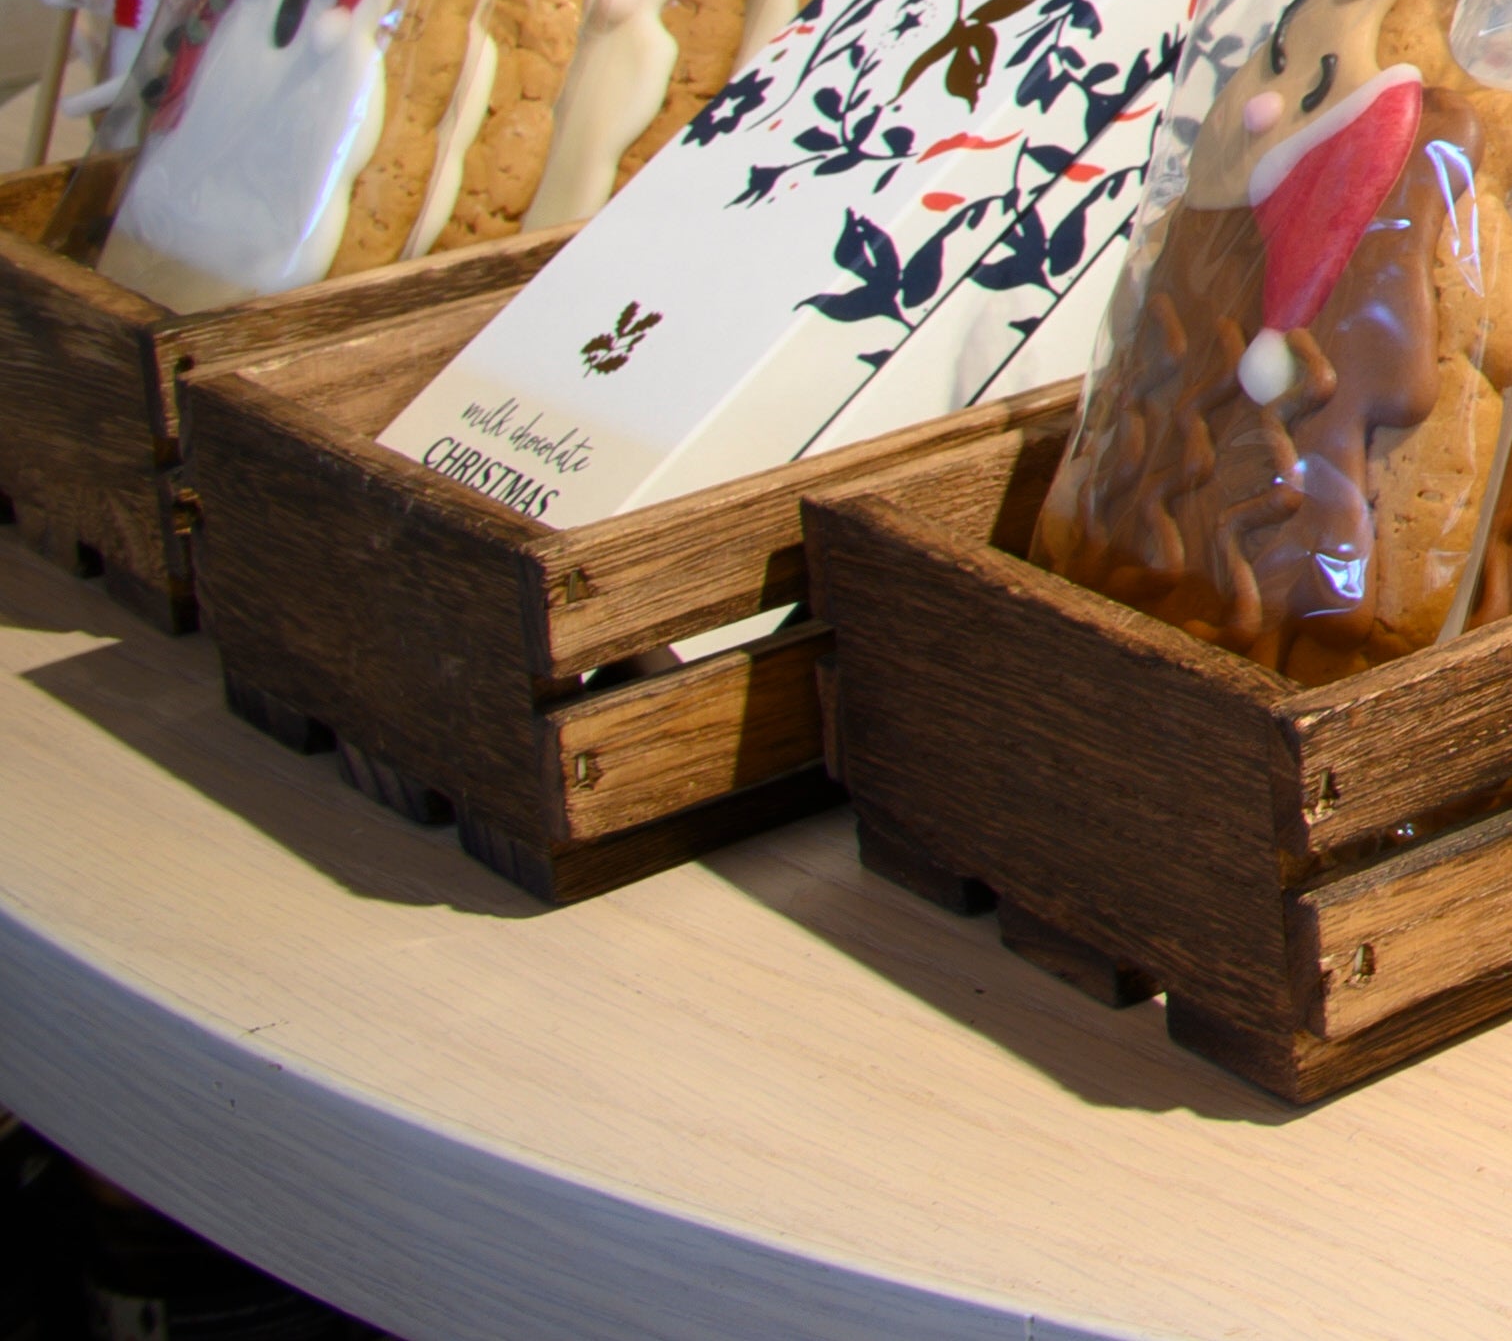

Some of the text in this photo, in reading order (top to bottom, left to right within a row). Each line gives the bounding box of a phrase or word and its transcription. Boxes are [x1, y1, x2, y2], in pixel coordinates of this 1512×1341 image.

[461, 397, 594, 474] milk chocolate
[422, 436, 560, 519] CHRISTMAS
